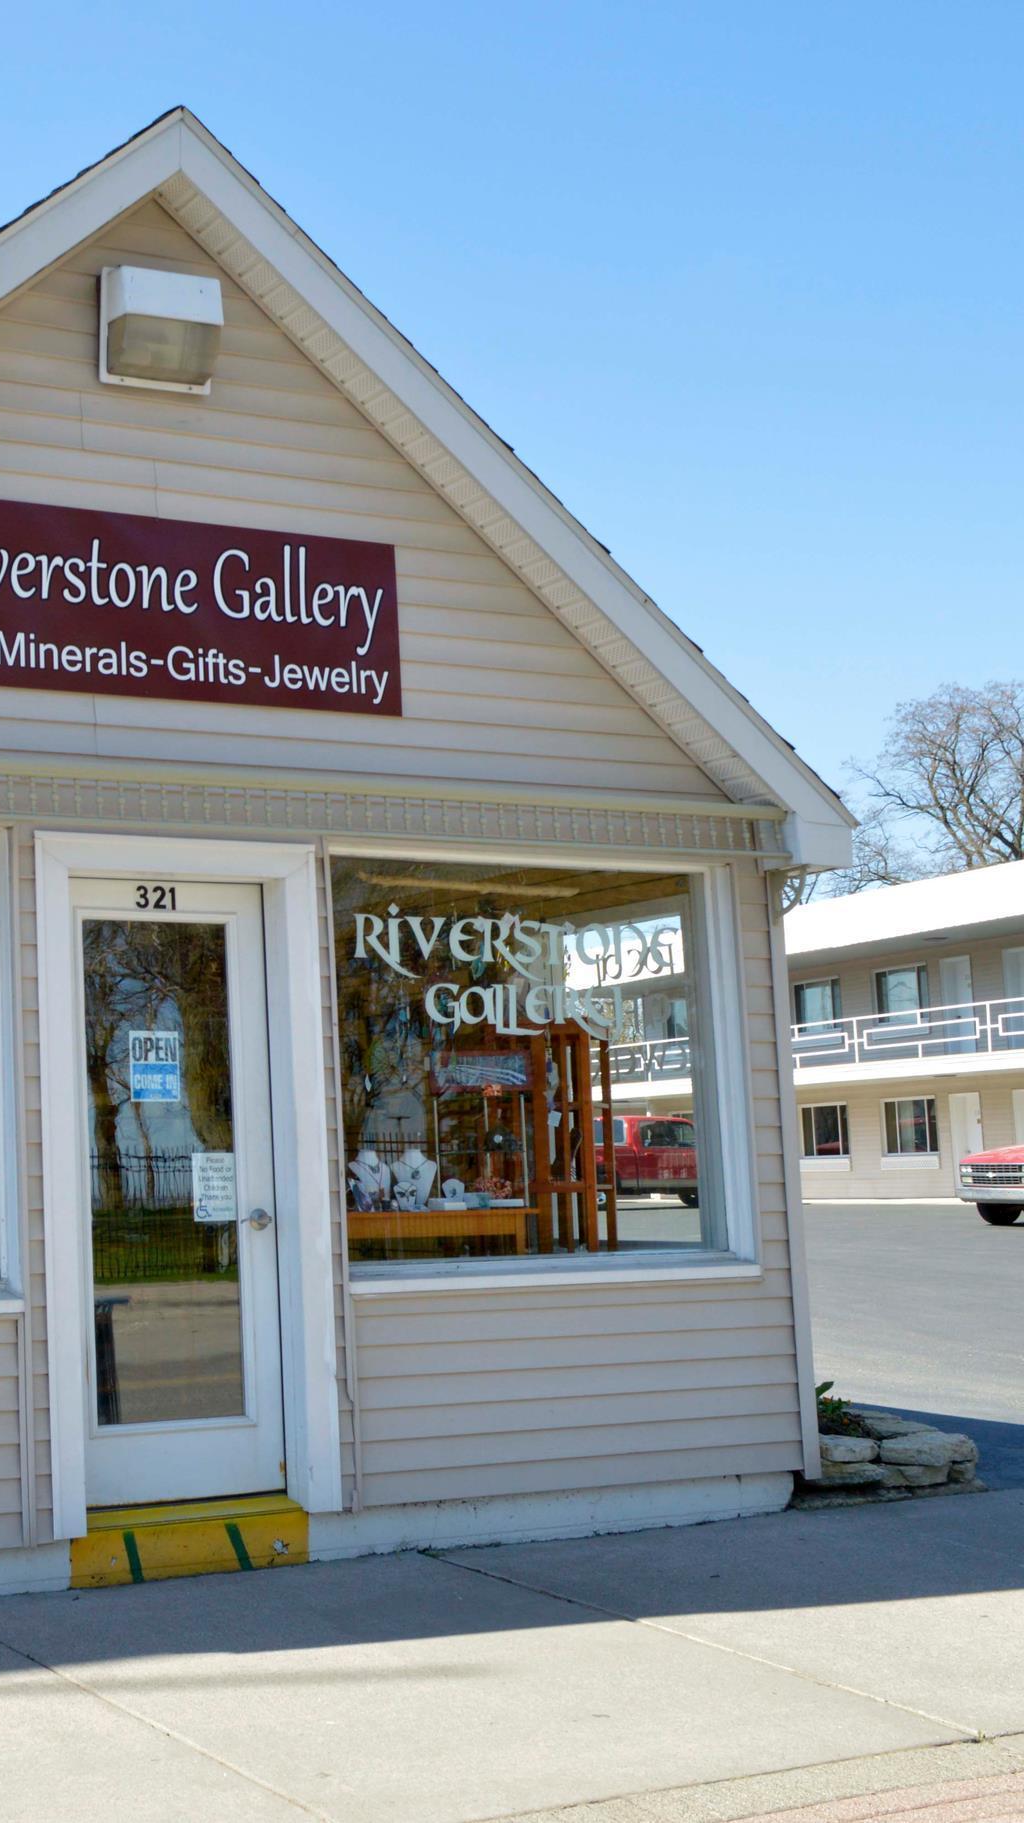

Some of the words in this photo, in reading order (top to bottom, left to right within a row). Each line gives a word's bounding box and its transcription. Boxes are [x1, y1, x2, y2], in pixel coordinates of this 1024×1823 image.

[213, 544, 384, 656] Gallery
[135, 885, 177, 911] 321
[131, 1037, 178, 1062] OPEN
